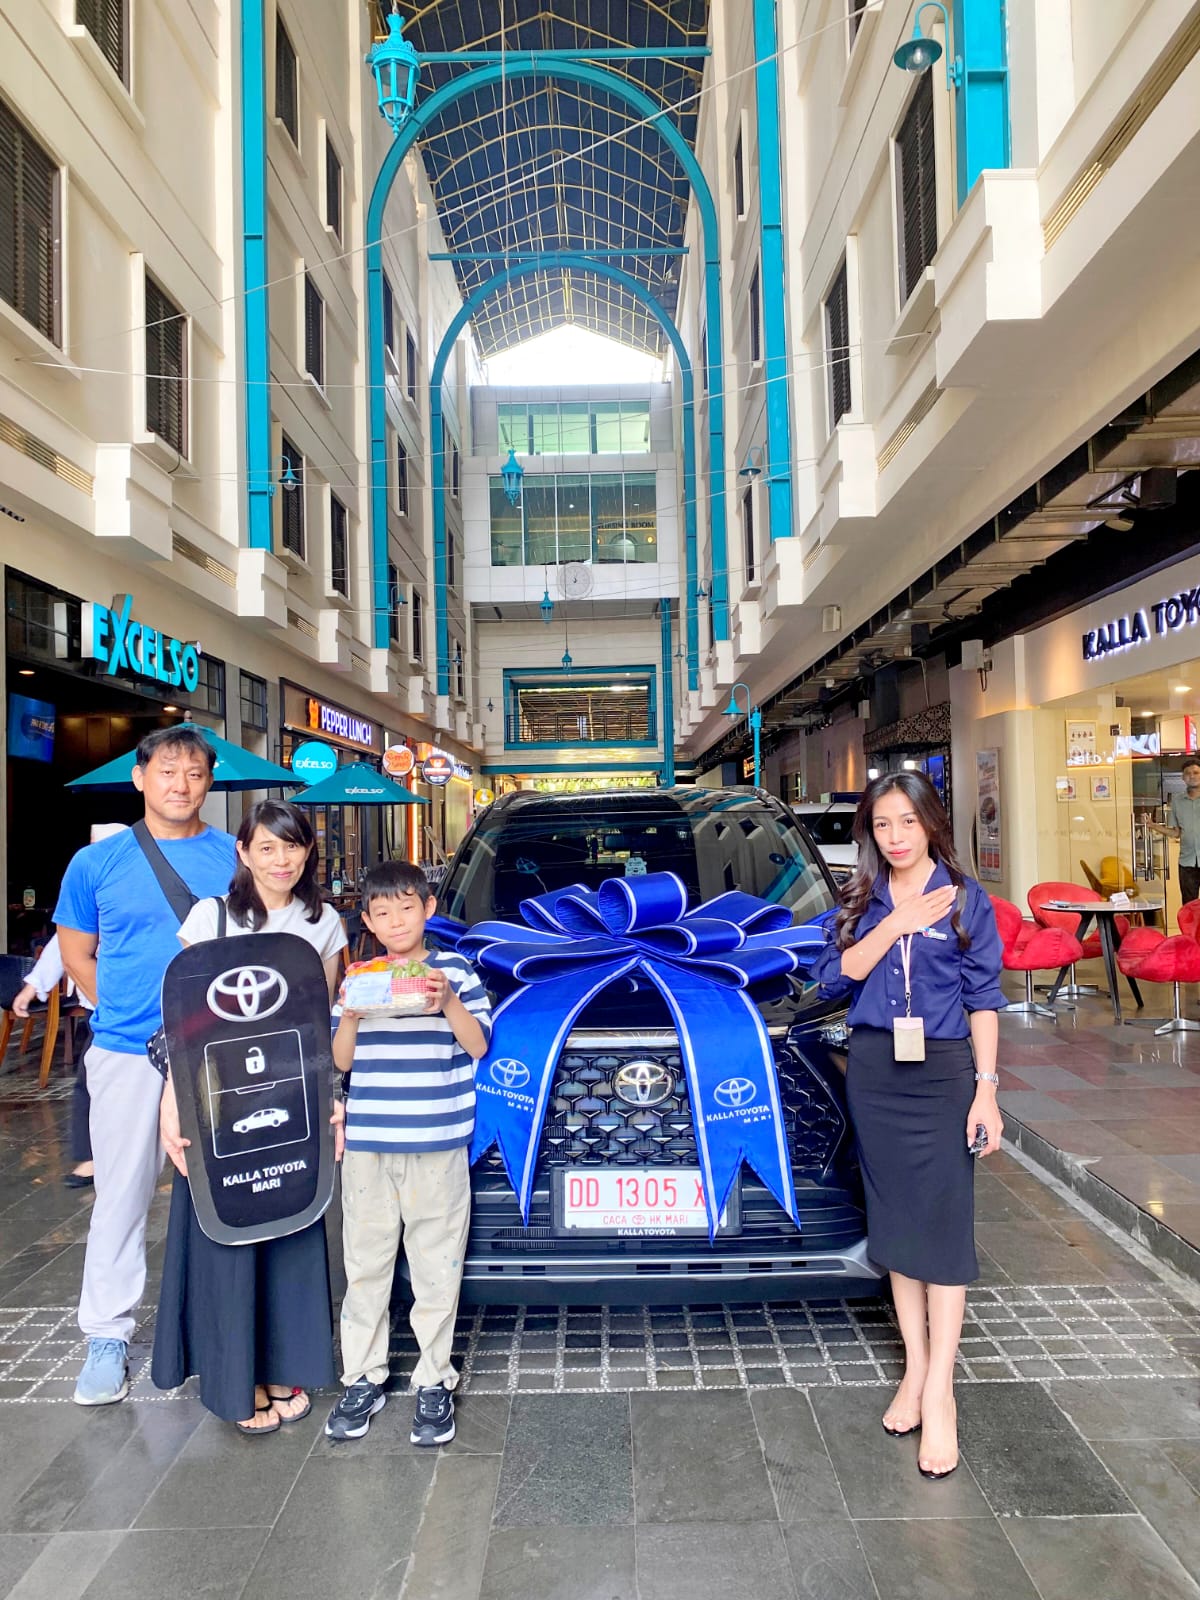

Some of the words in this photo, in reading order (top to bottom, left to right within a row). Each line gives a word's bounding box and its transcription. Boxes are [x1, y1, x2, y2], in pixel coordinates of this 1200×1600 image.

[1082, 610, 1148, 661] KALLA
[1151, 589, 1200, 634] TOY
[93, 593, 199, 692] EXCELSO
[321, 705, 347, 738] PEPPER
[348, 717, 372, 745] LUNCH
[296, 757, 333, 769] EXCELSO
[344, 786, 384, 795] EXCELSO
[223, 1169, 261, 1187] KALLA
[262, 1160, 307, 1178] TOYOTA
[252, 1178, 281, 1193] MARI
[569, 1177, 600, 1208] DD
[615, 1177, 677, 1208] 1305
[602, 1215, 627, 1225] CACA
[649, 1214, 662, 1225] HK
[665, 1214, 689, 1225] MARI
